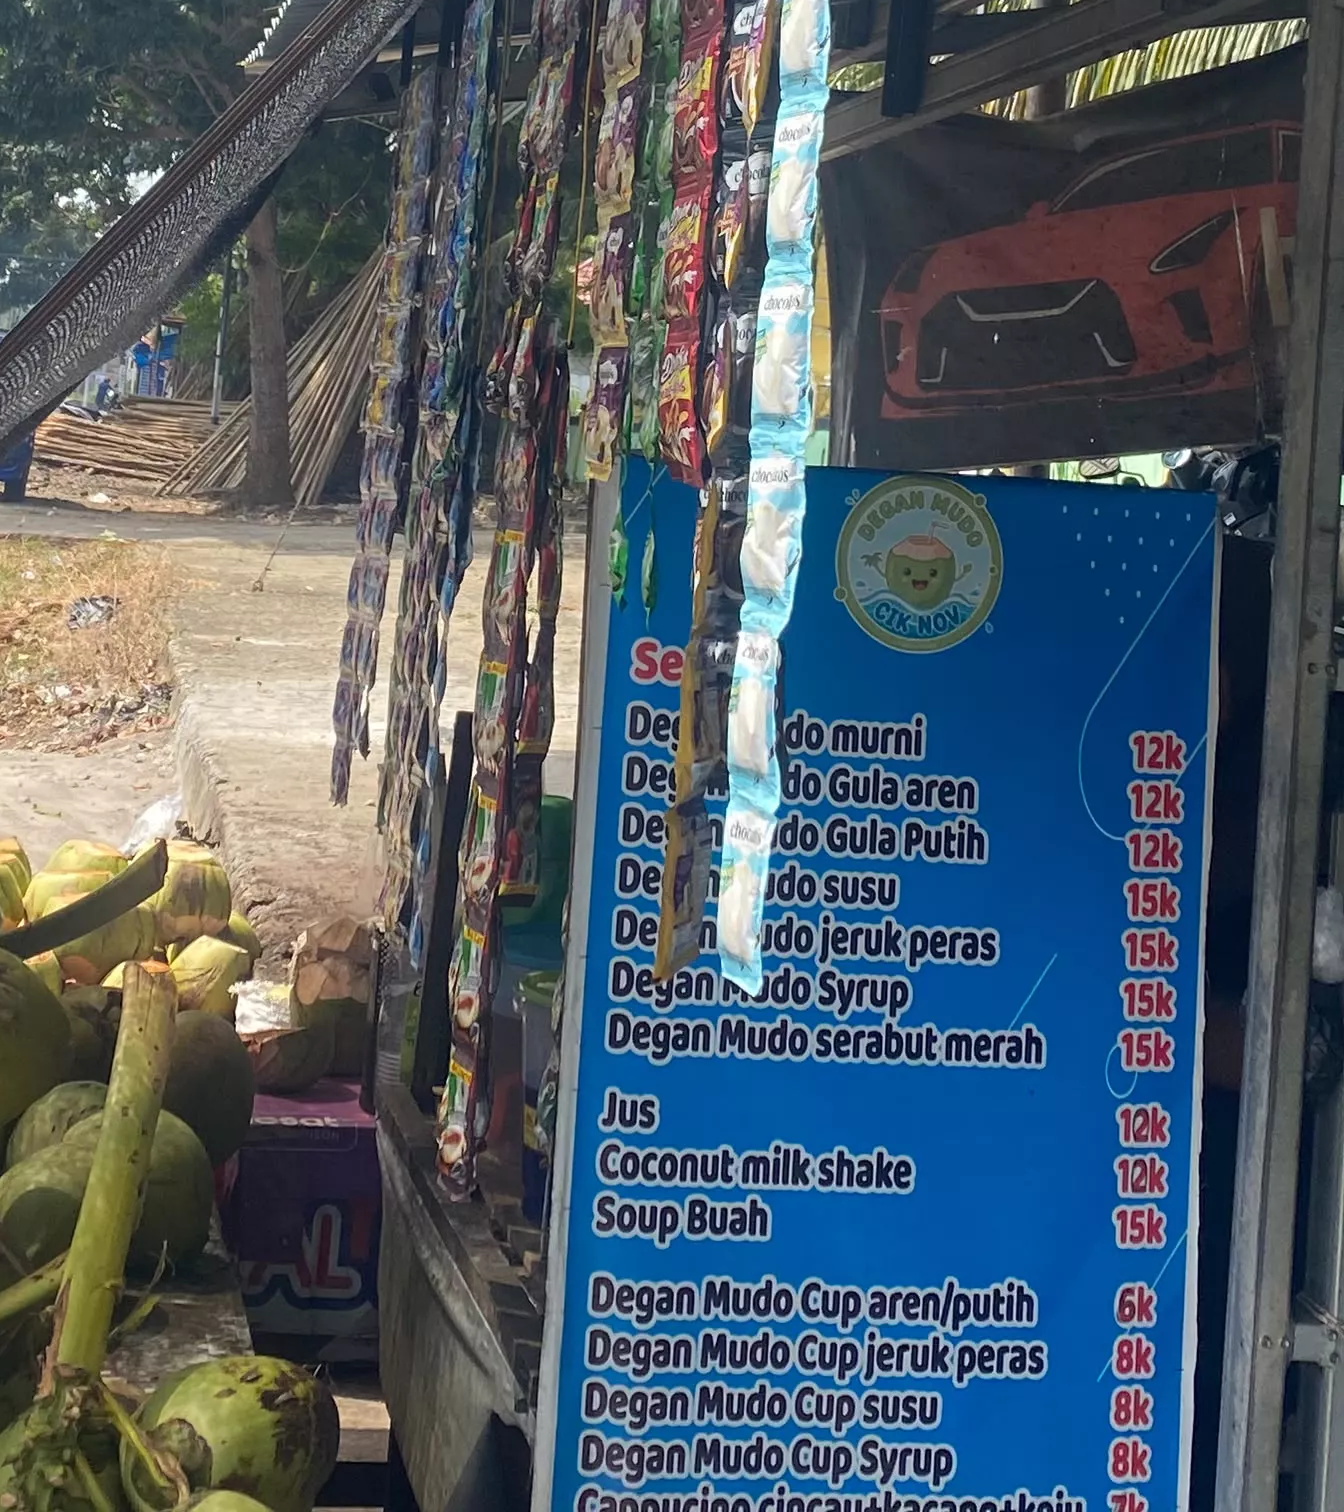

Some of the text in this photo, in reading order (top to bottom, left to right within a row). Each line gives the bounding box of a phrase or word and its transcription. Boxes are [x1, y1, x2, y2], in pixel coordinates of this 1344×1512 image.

[857, 490, 984, 548] DEGAN MUDO
[786, 714, 824, 750] do
[832, 718, 922, 756] murni
[1133, 735, 1181, 771] 12k
[782, 766, 822, 802] do
[829, 768, 898, 805] Gula
[906, 779, 974, 809] aren
[1131, 785, 1180, 819] 12k
[827, 818, 895, 855] Gula
[905, 820, 984, 859] Putih
[1130, 836, 1179, 868] 12k
[767, 867, 816, 904] udo
[824, 875, 895, 906] susu
[1128, 885, 1175, 917] 15k
[762, 918, 813, 954] udo
[819, 919, 901, 963] jeruk
[910, 931, 995, 966] peras
[1127, 934, 1174, 967] 15k
[612, 962, 713, 1008] Degan
[819, 971, 908, 1017] Syrup
[1125, 983, 1173, 1016] 15k
[609, 1014, 1042, 1063] Degan Mudo serabut merah
[1122, 1033, 1171, 1067] 15k
[602, 1092, 654, 1128] Jus
[1120, 1108, 1168, 1142] 12k
[600, 1144, 911, 1188] Coconut milk shake
[1118, 1159, 1166, 1193] 12k
[597, 1196, 767, 1243] Soup Buah
[1116, 1210, 1164, 1244] 15k
[592, 1277, 1033, 1330] Degan Mudo Cup aren/putih
[1117, 1289, 1154, 1322] 6k
[589, 1330, 1043, 1382] Degan Mudo Cup jeruk peras
[1115, 1341, 1152, 1375] 8k
[585, 1382, 937, 1432] Degan Mudo Cup susu
[1113, 1393, 1149, 1426] 8k
[582, 1435, 952, 1486] Degan Mudo Cup Syrup
[1111, 1445, 1147, 1477] 8k
